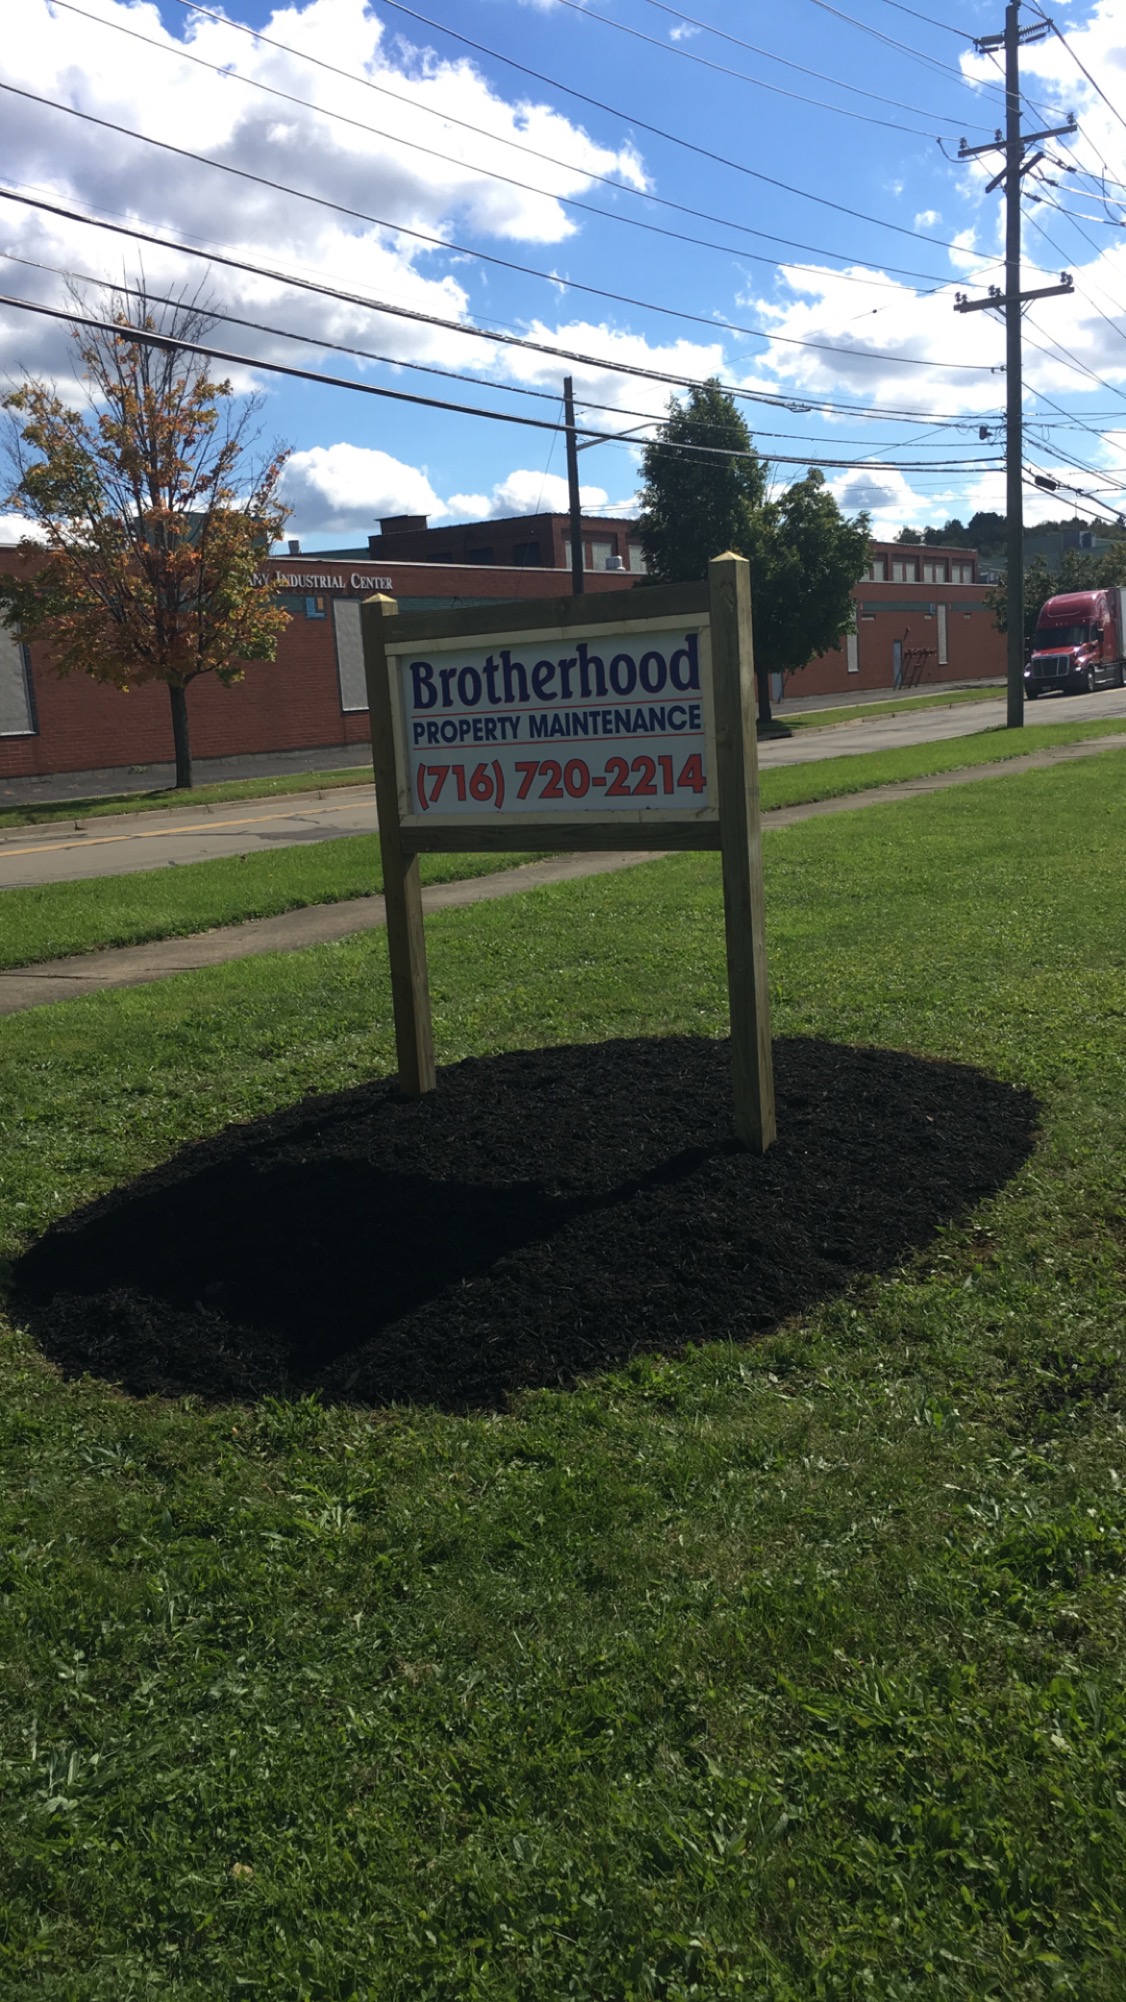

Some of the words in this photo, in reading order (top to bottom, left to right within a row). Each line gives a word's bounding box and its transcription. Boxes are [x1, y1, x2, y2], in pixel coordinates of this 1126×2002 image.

[276, 571, 346, 588] INDUSTRIAL
[351, 573, 394, 590] CENTER
[410, 633, 701, 709] Brotherhood
[413, 716, 521, 745] PROPERTY
[529, 704, 701, 738] MAINTENANCE
[417, 759, 505, 811] (716)
[515, 753, 707, 800] 720-2214
